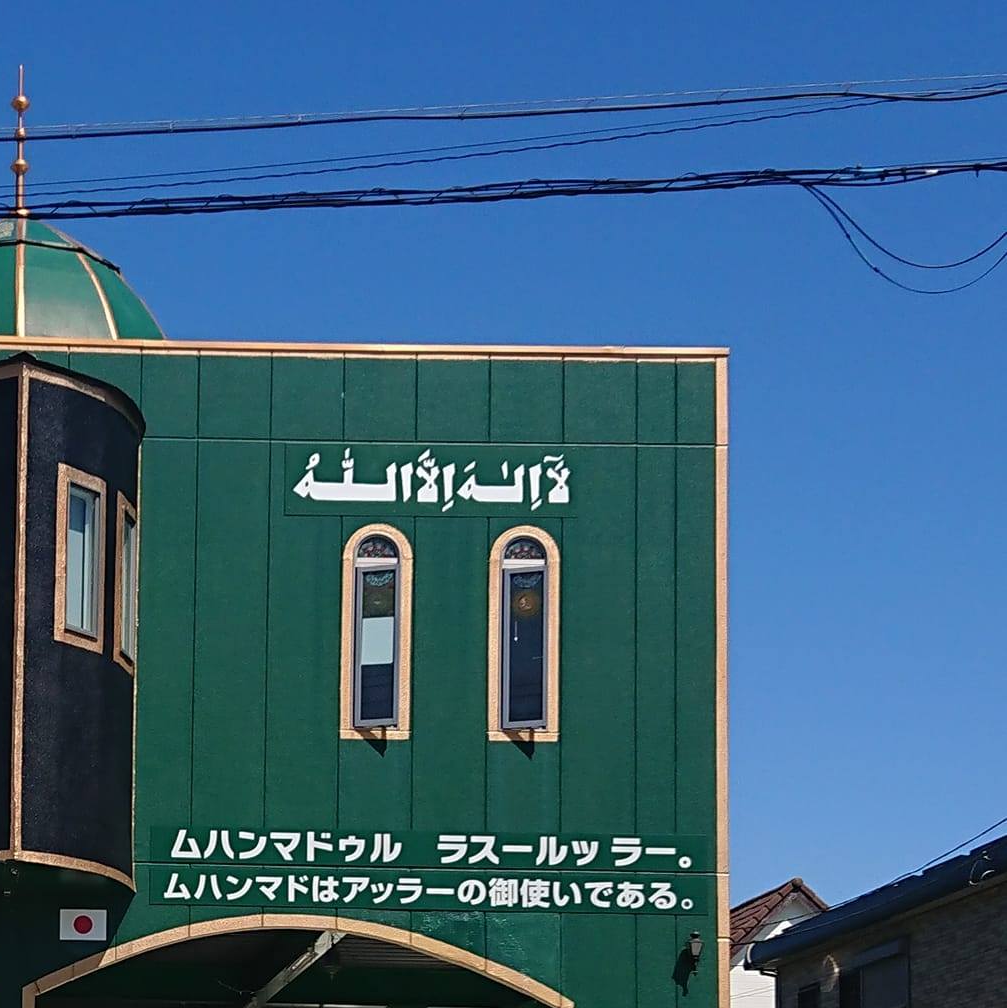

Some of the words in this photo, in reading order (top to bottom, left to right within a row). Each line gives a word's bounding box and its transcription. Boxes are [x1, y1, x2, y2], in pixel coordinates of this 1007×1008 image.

[170, 829, 402, 863] ムハンマドゥル
[163, 872, 694, 910] ムハンマドはアッラーの御使いである。
